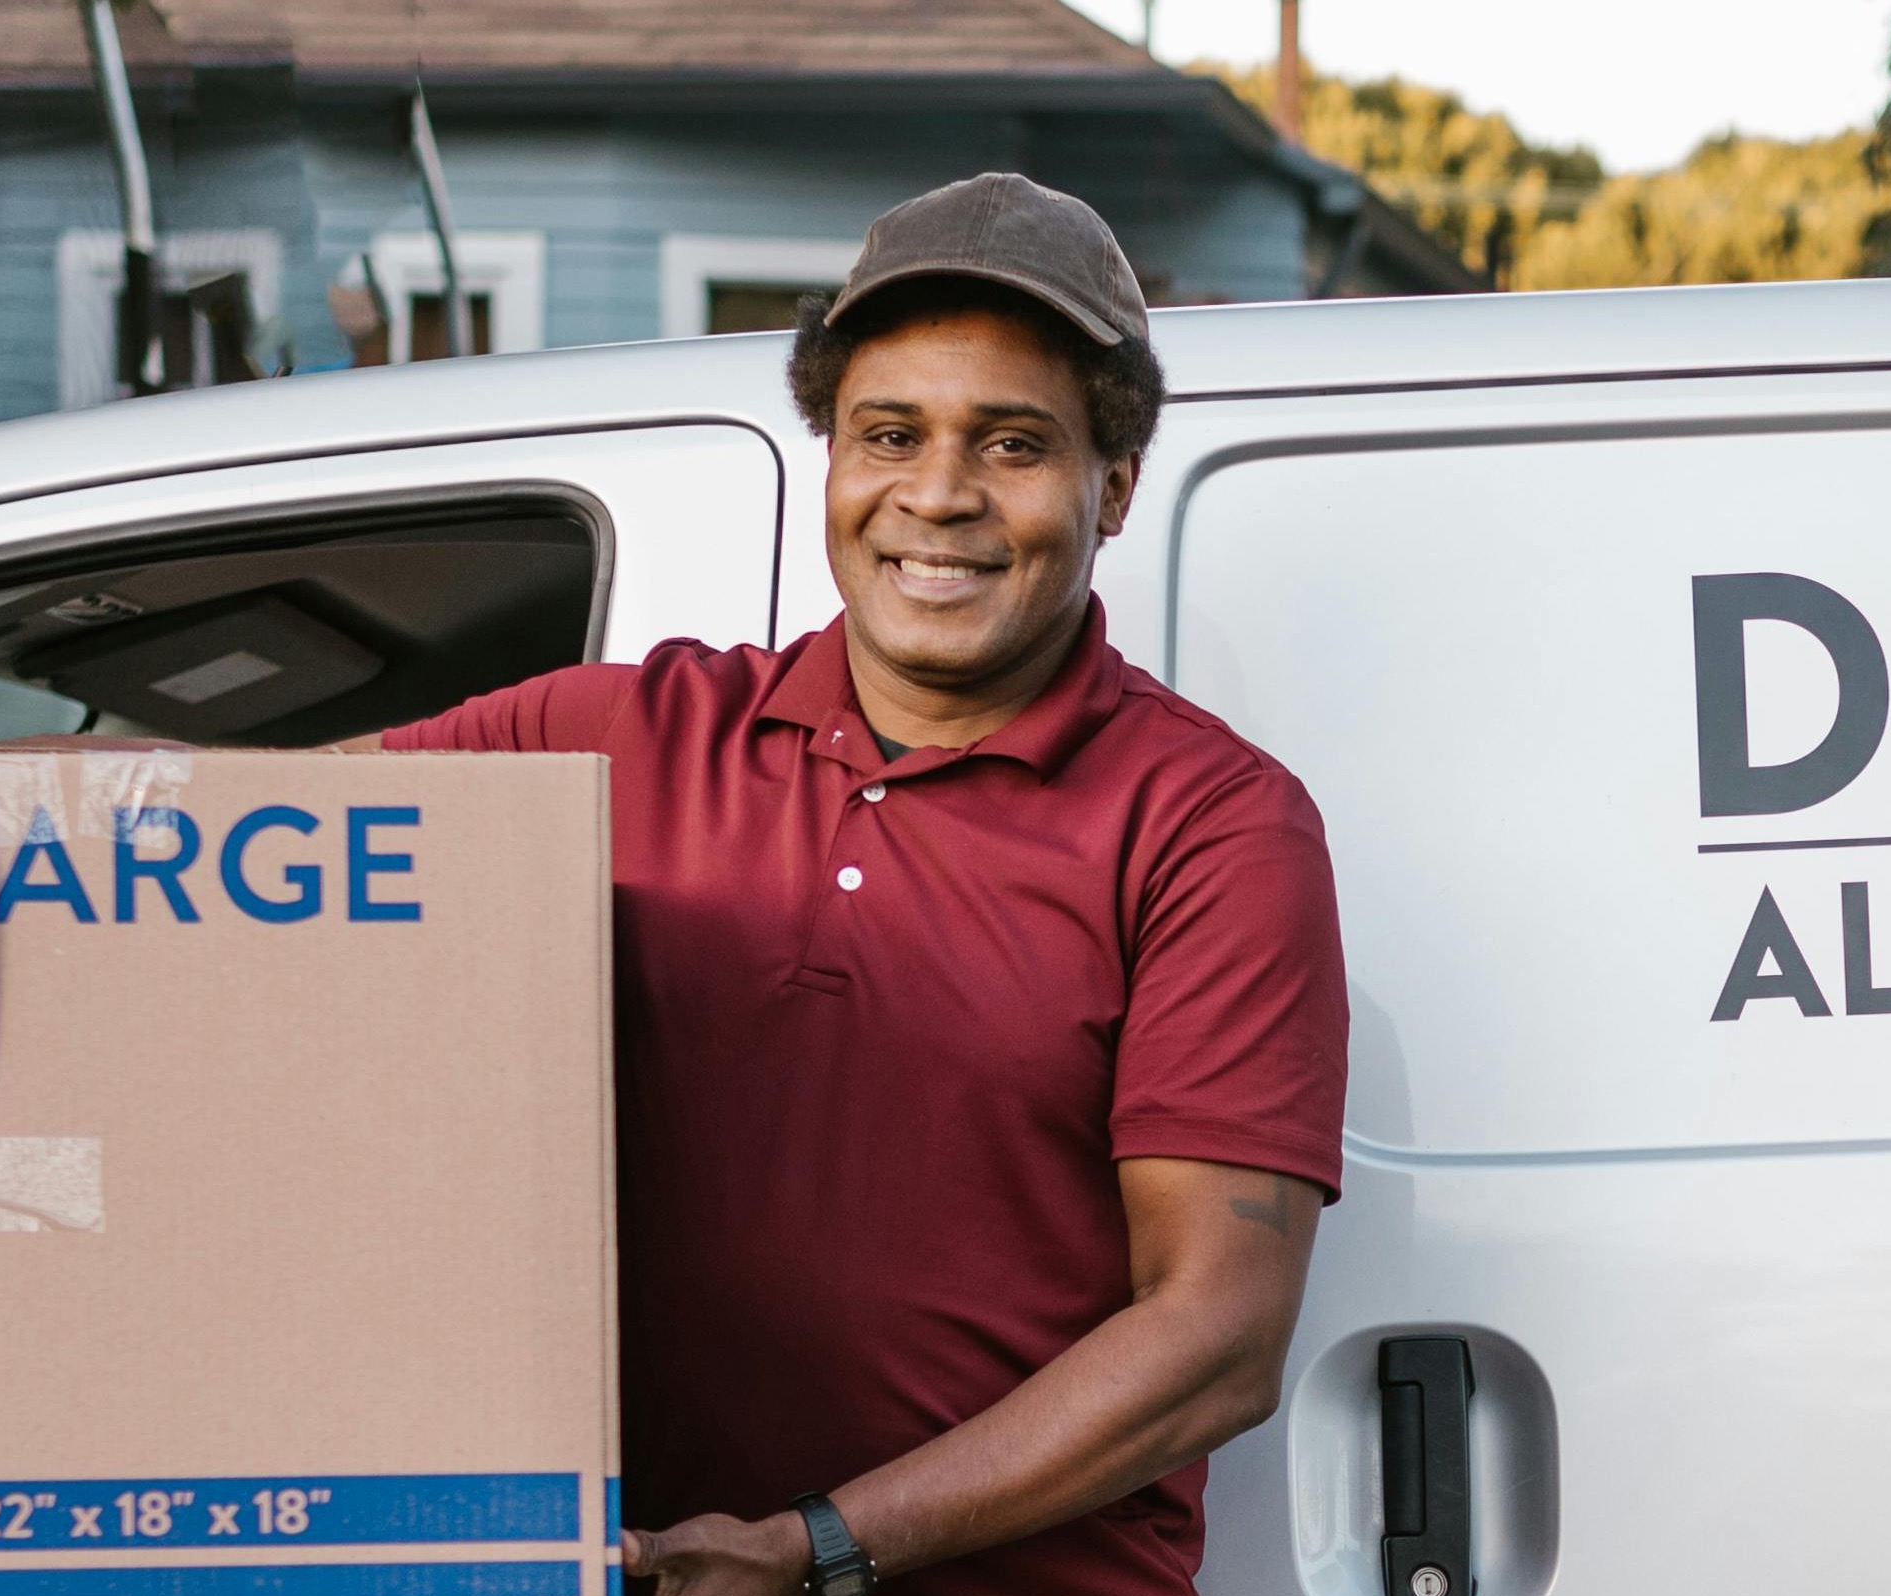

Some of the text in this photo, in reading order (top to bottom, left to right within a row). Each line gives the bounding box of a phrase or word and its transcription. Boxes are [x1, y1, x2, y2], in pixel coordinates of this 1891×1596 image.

[72, 1508, 101, 1537] x
[117, 1492, 194, 1537] 18"
[209, 1506, 239, 1535] x
[255, 1490, 331, 1534] 18"
